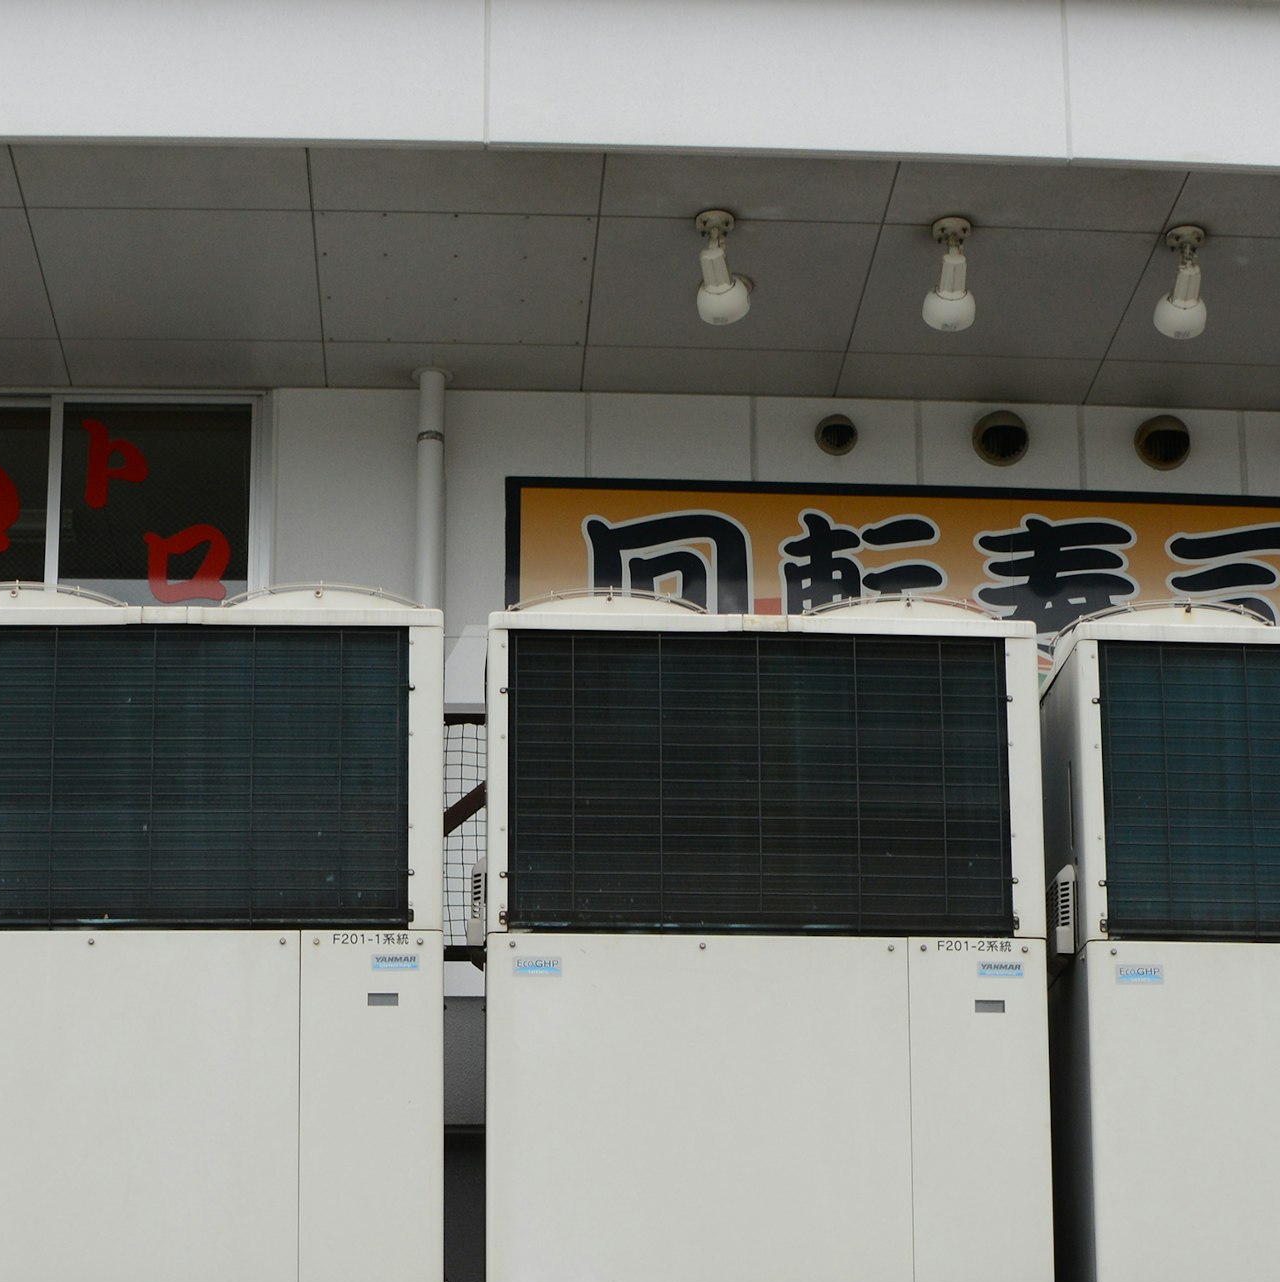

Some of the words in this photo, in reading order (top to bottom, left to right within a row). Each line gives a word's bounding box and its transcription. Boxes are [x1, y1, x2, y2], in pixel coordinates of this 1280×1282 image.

[332, 932, 410, 946] F201-1系統
[936, 939, 1013, 952] F201-2系統
[375, 955, 418, 964] YANMAR
[980, 963, 1021, 972] YANMAR
